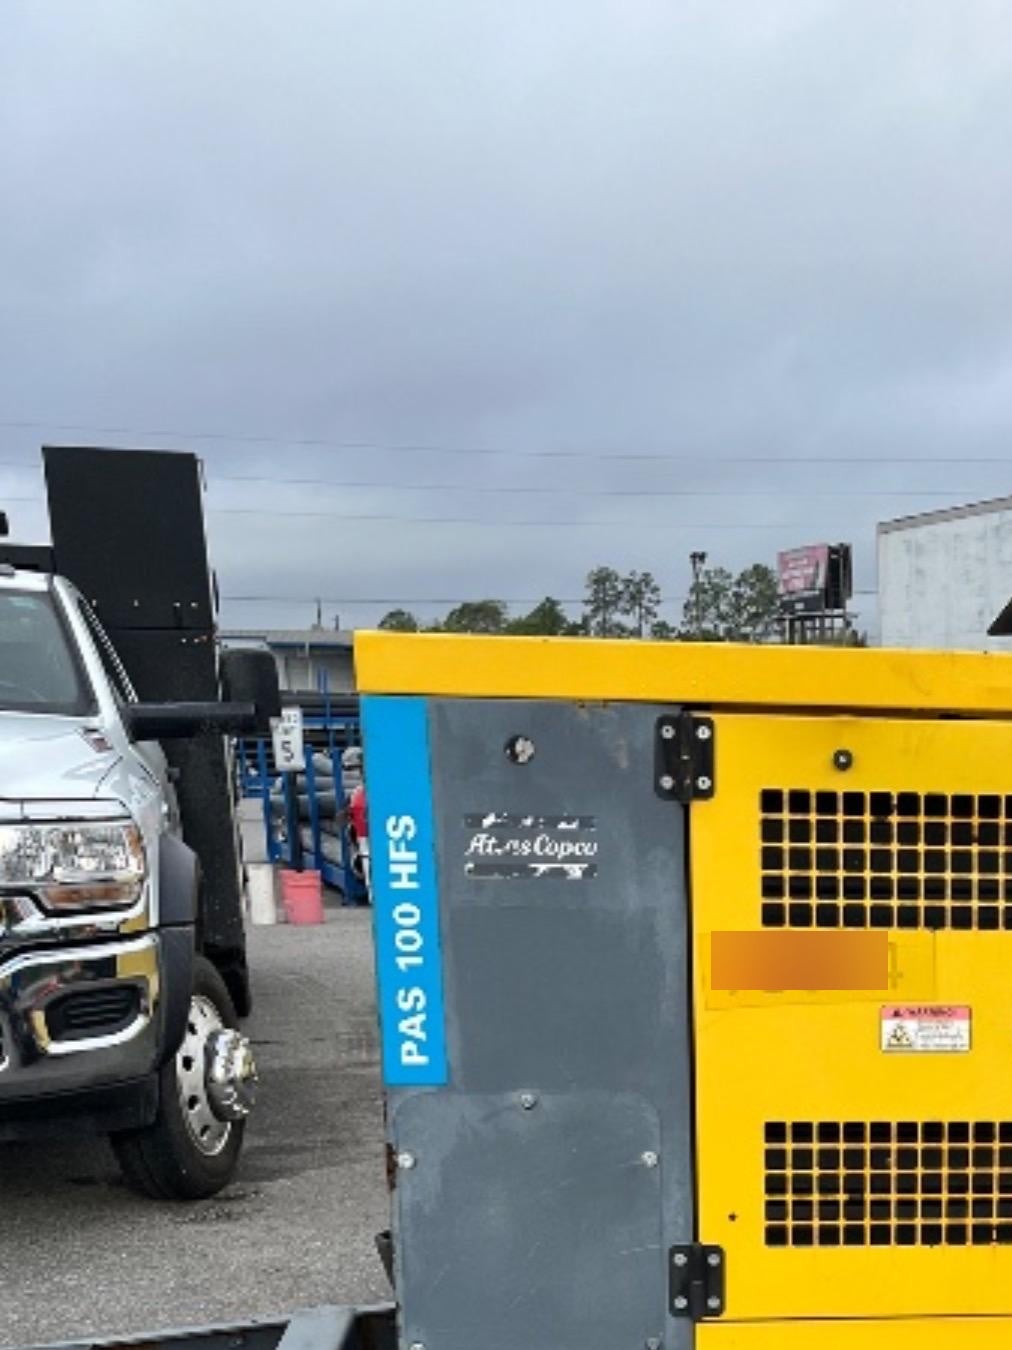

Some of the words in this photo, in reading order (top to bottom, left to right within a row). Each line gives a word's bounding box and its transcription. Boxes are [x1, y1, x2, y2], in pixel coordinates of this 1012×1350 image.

[385, 814, 421, 890] HFS
[463, 832, 532, 856] Atas
[391, 902, 424, 973] 100
[396, 986, 430, 1066] PAS
